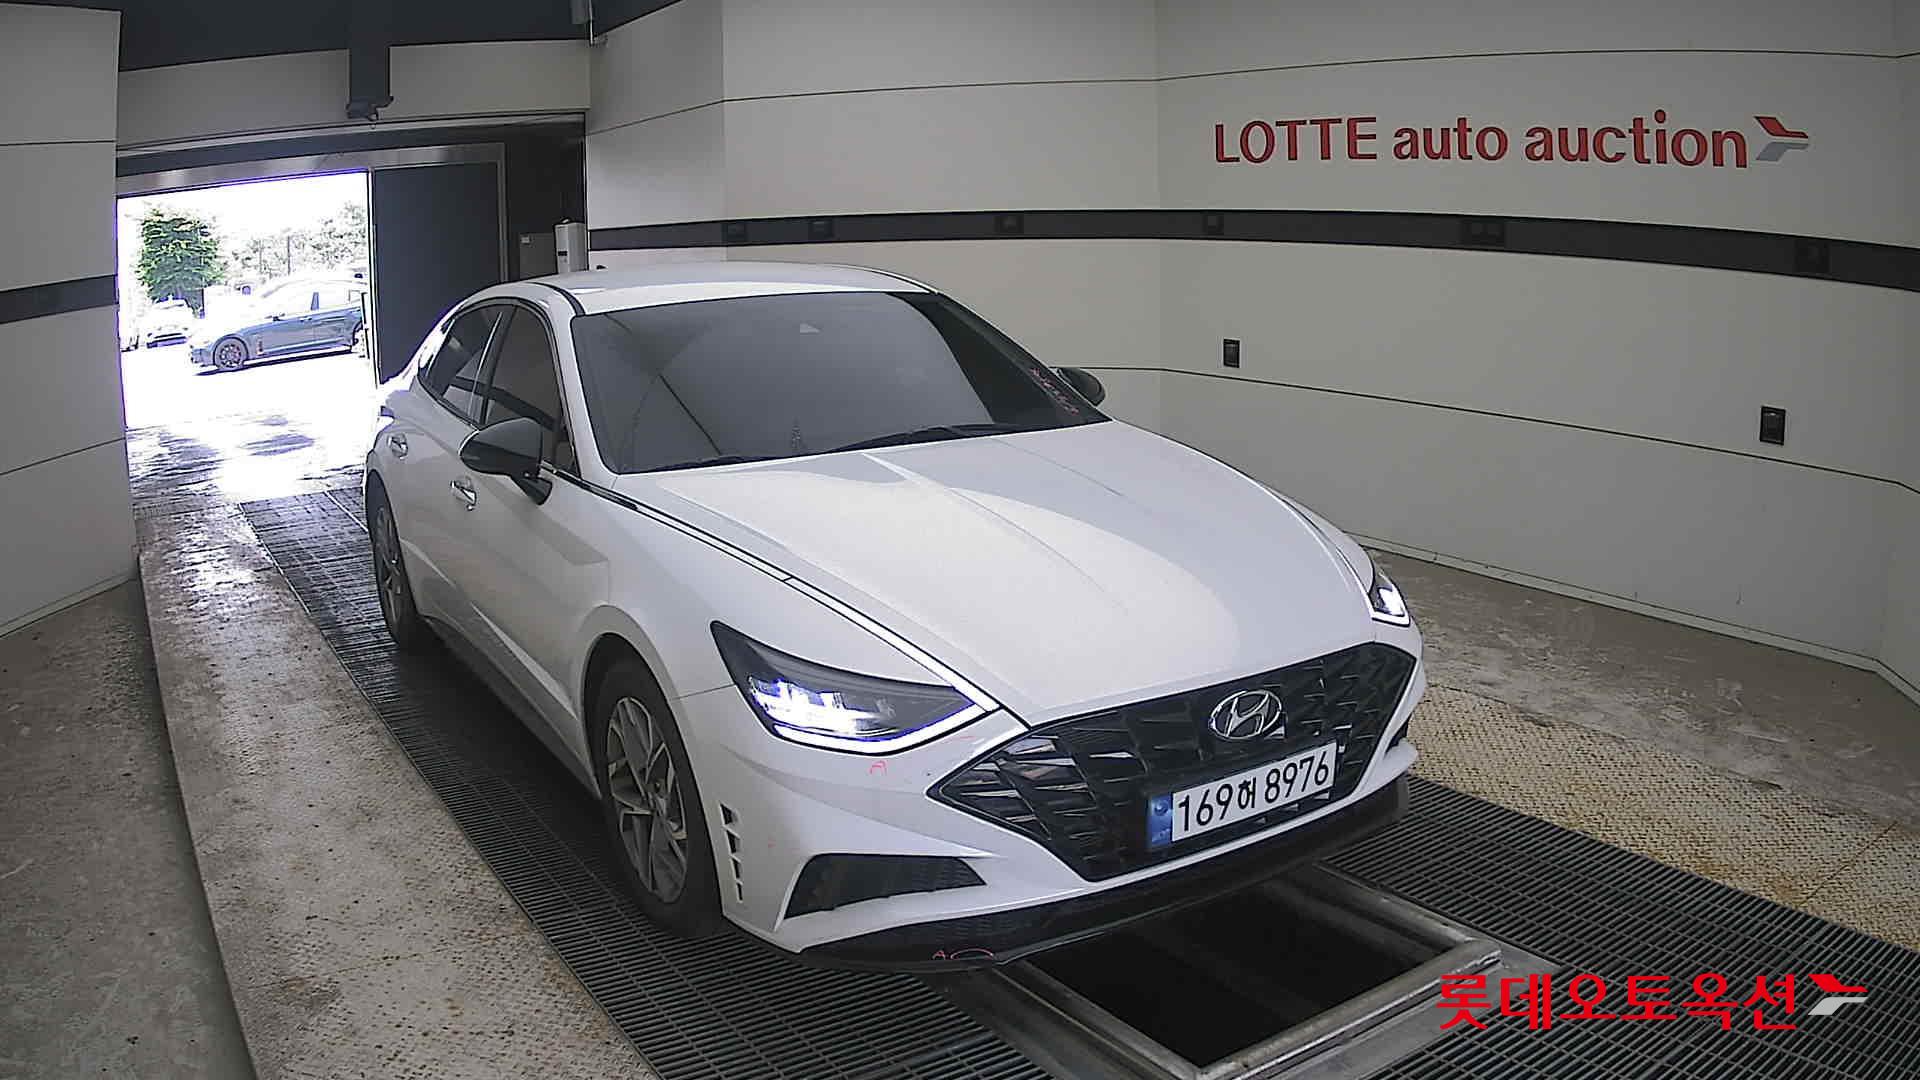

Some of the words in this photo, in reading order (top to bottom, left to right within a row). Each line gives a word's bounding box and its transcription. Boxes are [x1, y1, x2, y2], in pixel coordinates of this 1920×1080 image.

[1214, 116, 1377, 163] LOTTE
[1392, 117, 1509, 162] auto
[1524, 109, 1749, 169] auction
[1178, 776, 1257, 832] 169허
[1264, 750, 1330, 804] 8976
